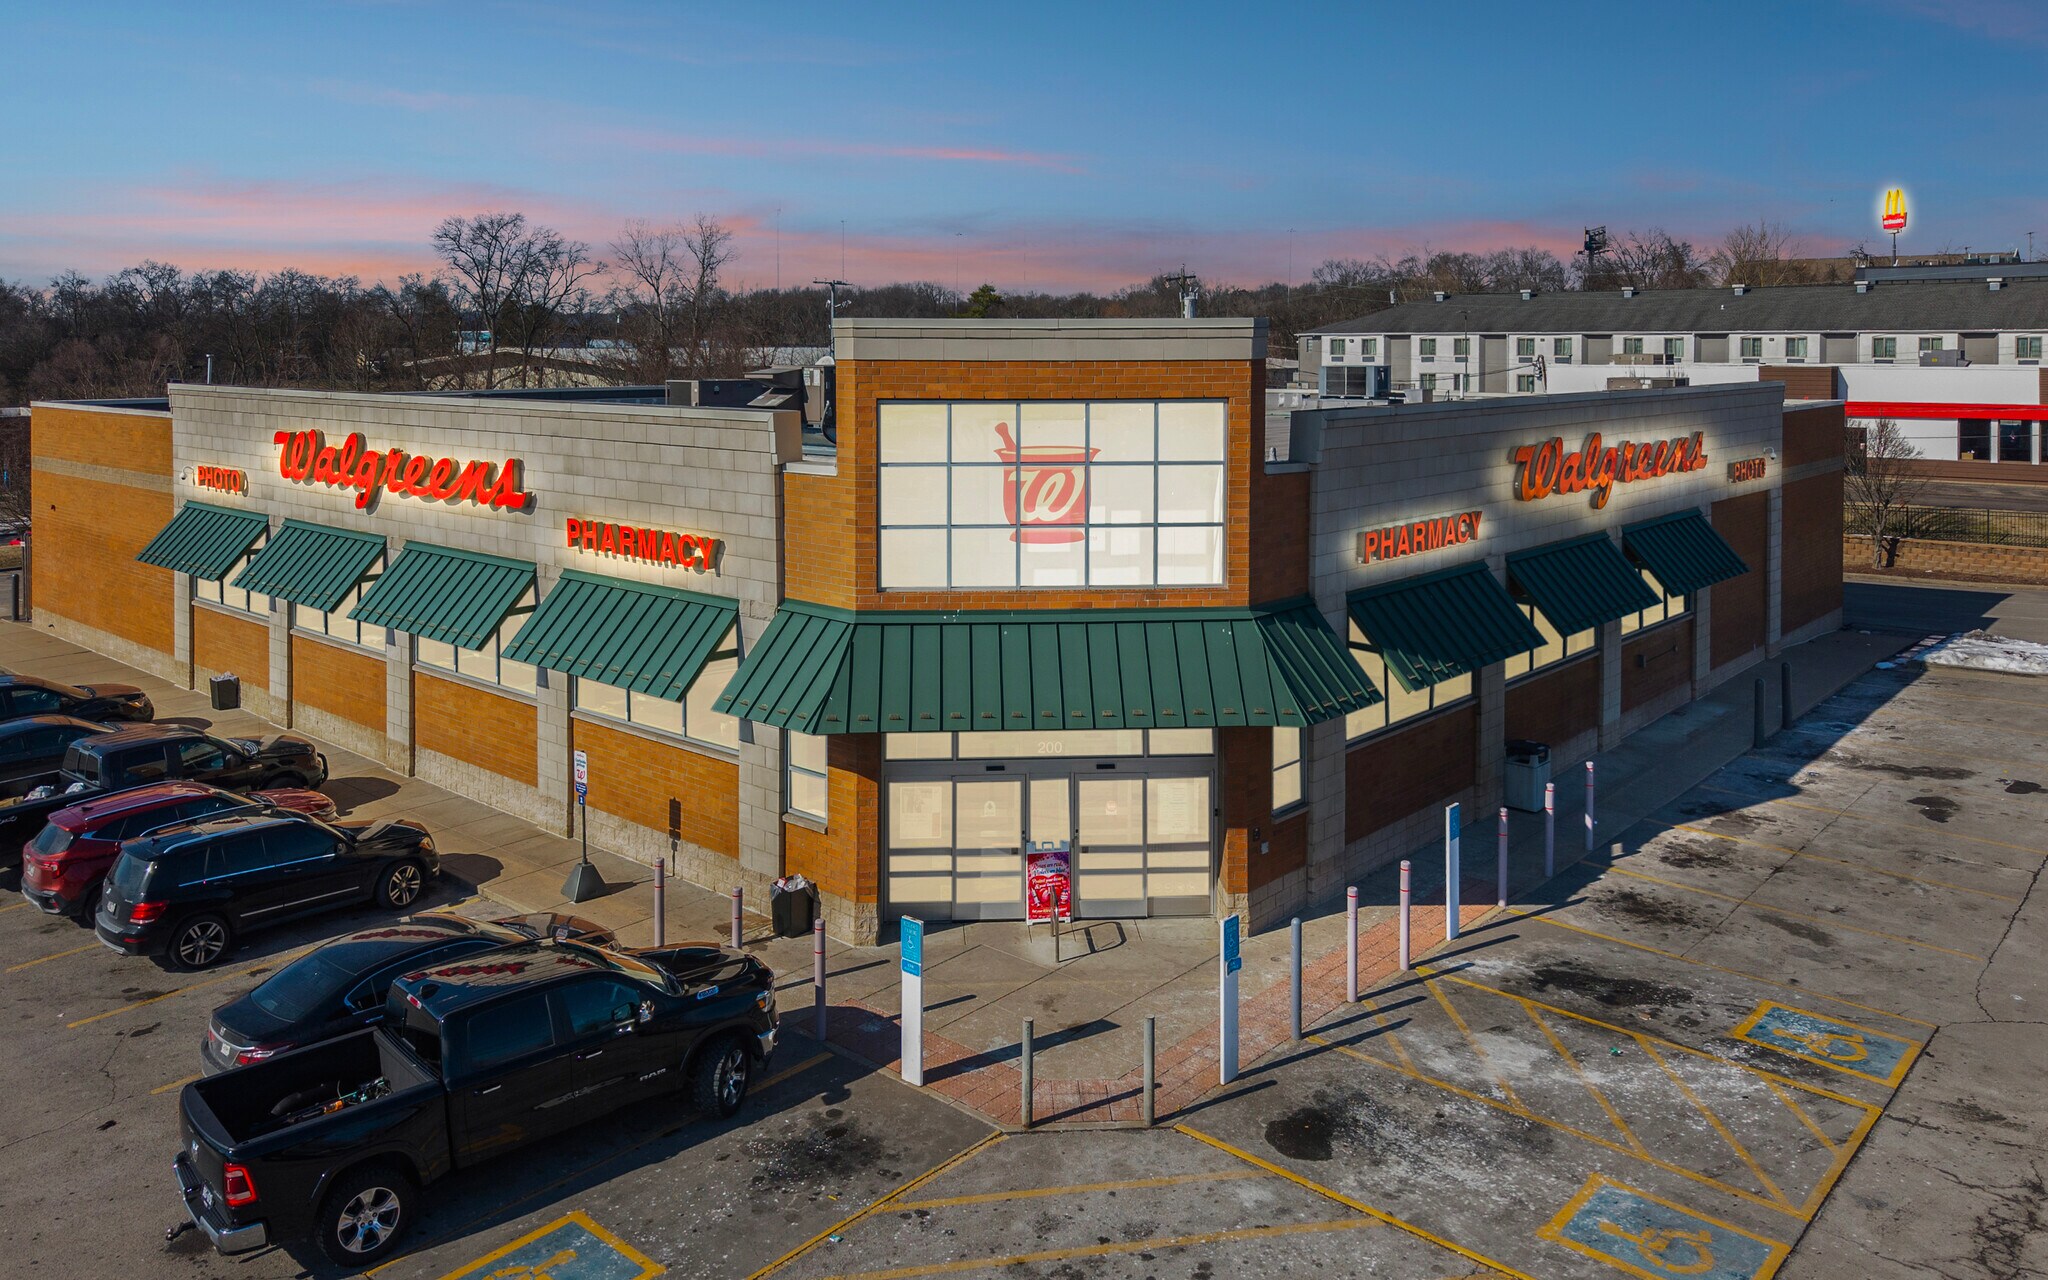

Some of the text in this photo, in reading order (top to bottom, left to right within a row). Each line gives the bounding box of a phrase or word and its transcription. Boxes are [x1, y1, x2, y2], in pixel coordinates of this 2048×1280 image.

[197, 464, 242, 494] PHOTO
[272, 428, 528, 510] Walgreens
[1514, 431, 1709, 510] Walgreens
[1732, 456, 1768, 484] PHOTO
[566, 516, 716, 571] PHARMACY
[1364, 511, 1482, 565] PHARMACY
[1037, 741, 1063, 754] 200
